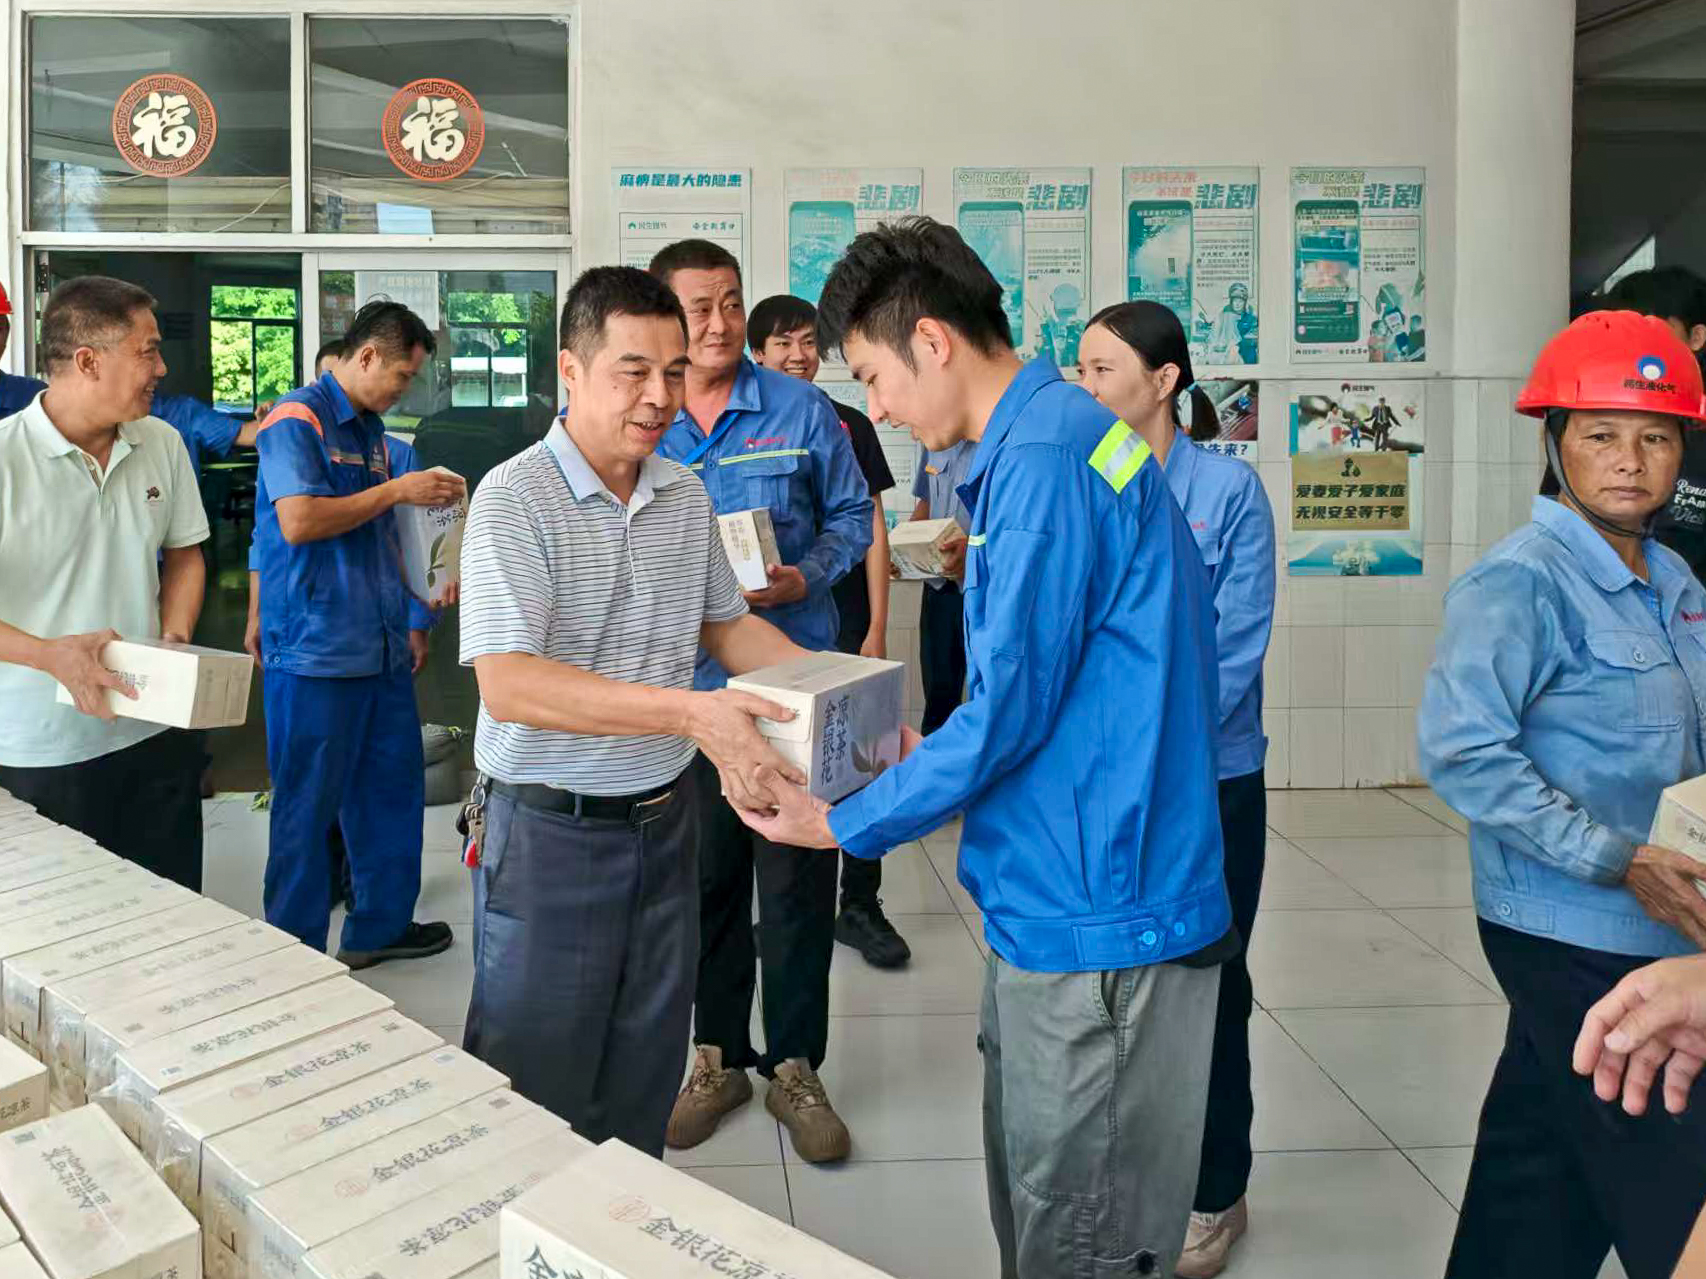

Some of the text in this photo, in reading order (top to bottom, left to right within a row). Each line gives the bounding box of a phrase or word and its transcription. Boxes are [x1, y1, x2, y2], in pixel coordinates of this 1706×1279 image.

[131, 92, 196, 158] 福
[400, 96, 465, 161] 福
[619, 172, 742, 188] 麻痹是最大的隐患
[857, 183, 920, 211] 悲剧
[1025, 183, 1089, 211] 悲剧
[1194, 183, 1257, 209] 悲剧
[1362, 183, 1422, 209] 悲剧
[1296, 484, 1407, 498] 爱妻爱子爱家庭
[1295, 506, 1405, 519] 无视安全等于零
[264, 1040, 371, 1089] 金银花凉茶
[318, 1078, 432, 1130] 金银花凉茶
[371, 1123, 489, 1183] 金银花凉茶
[638, 1216, 800, 1279] 金银花凉
